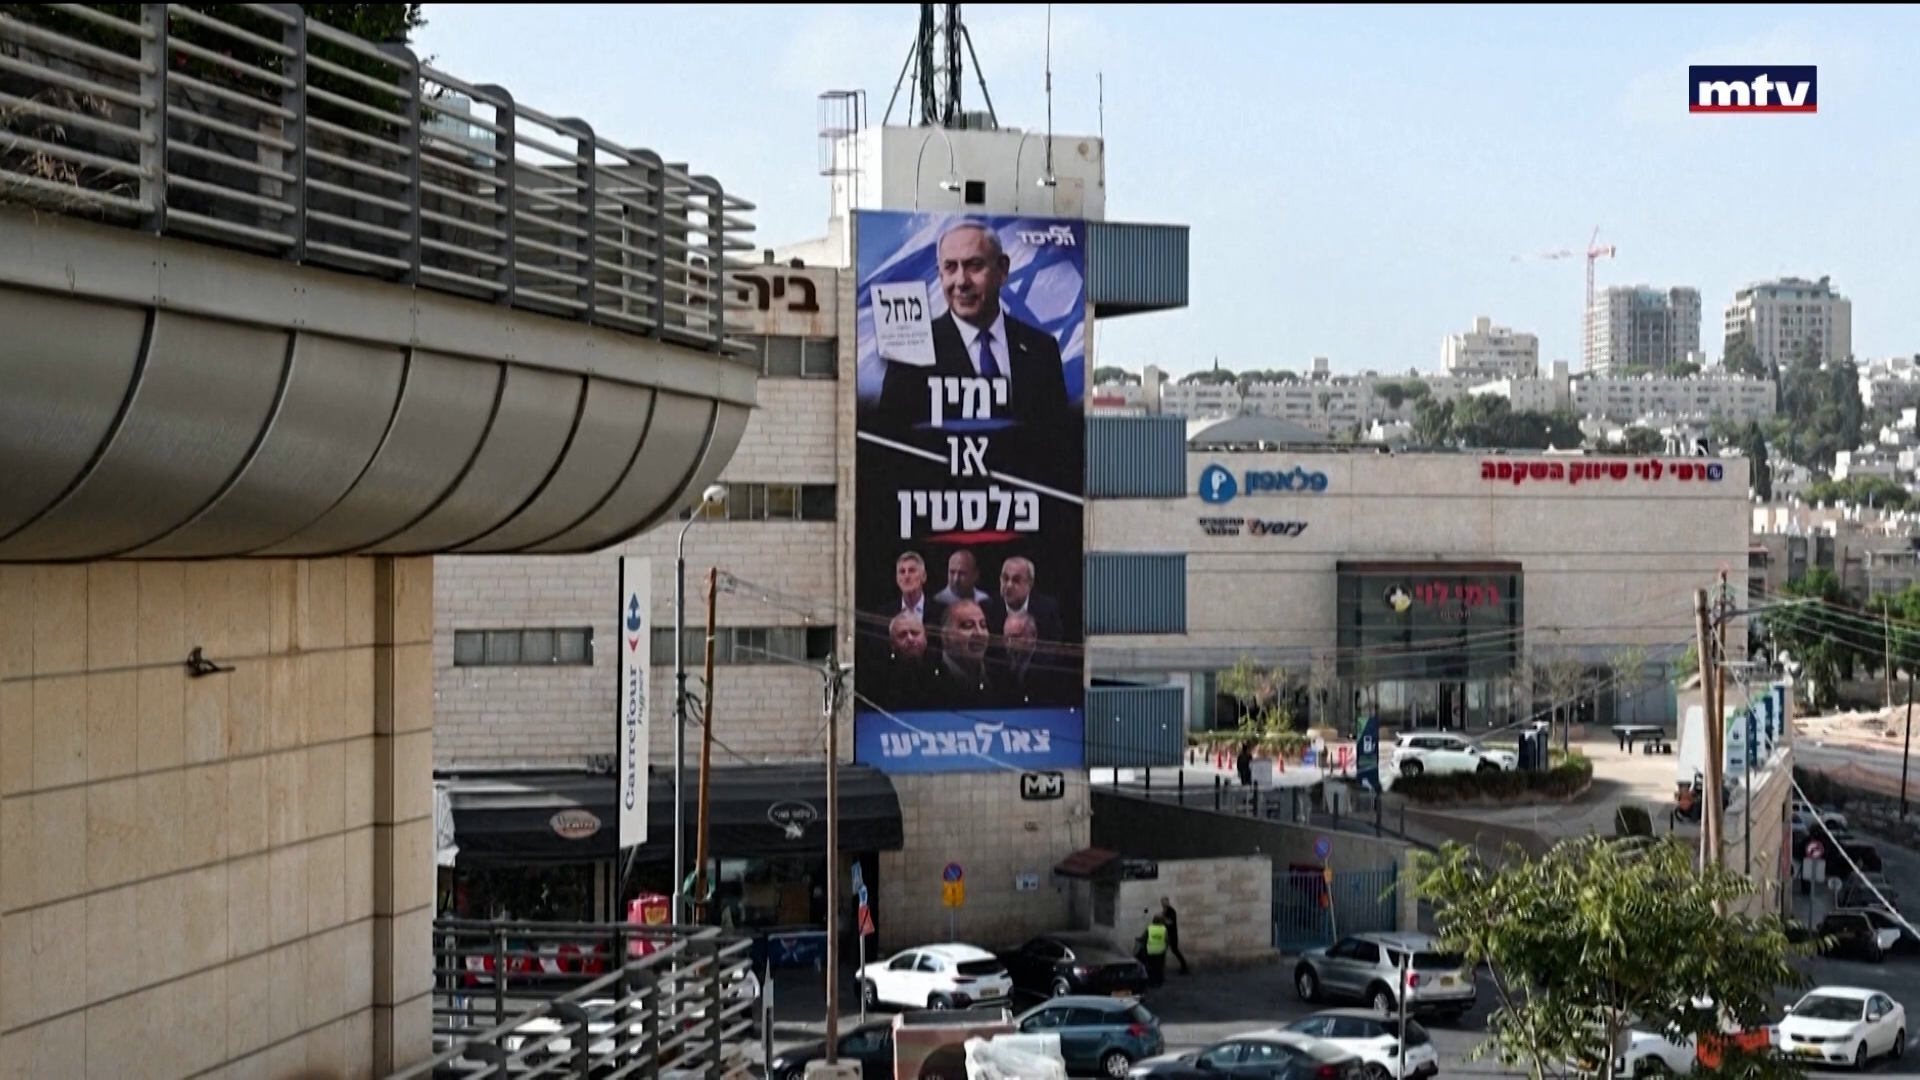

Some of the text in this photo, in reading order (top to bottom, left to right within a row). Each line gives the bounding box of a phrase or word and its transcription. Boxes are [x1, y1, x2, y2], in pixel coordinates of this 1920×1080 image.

[1016, 225, 1076, 246] הליכוד
[878, 288, 922, 324] מחל
[927, 377, 1008, 427] ימין
[947, 436, 989, 476] או
[1481, 459, 1705, 486] רמי לוי שיווק השקמה
[1245, 465, 1328, 496] פלאפון
[898, 485, 1039, 539] פלסטין
[1415, 581, 1499, 608] רמי לוי
[626, 664, 637, 811] Carrefour
[880, 722, 1050, 757] צאו להצביע!
